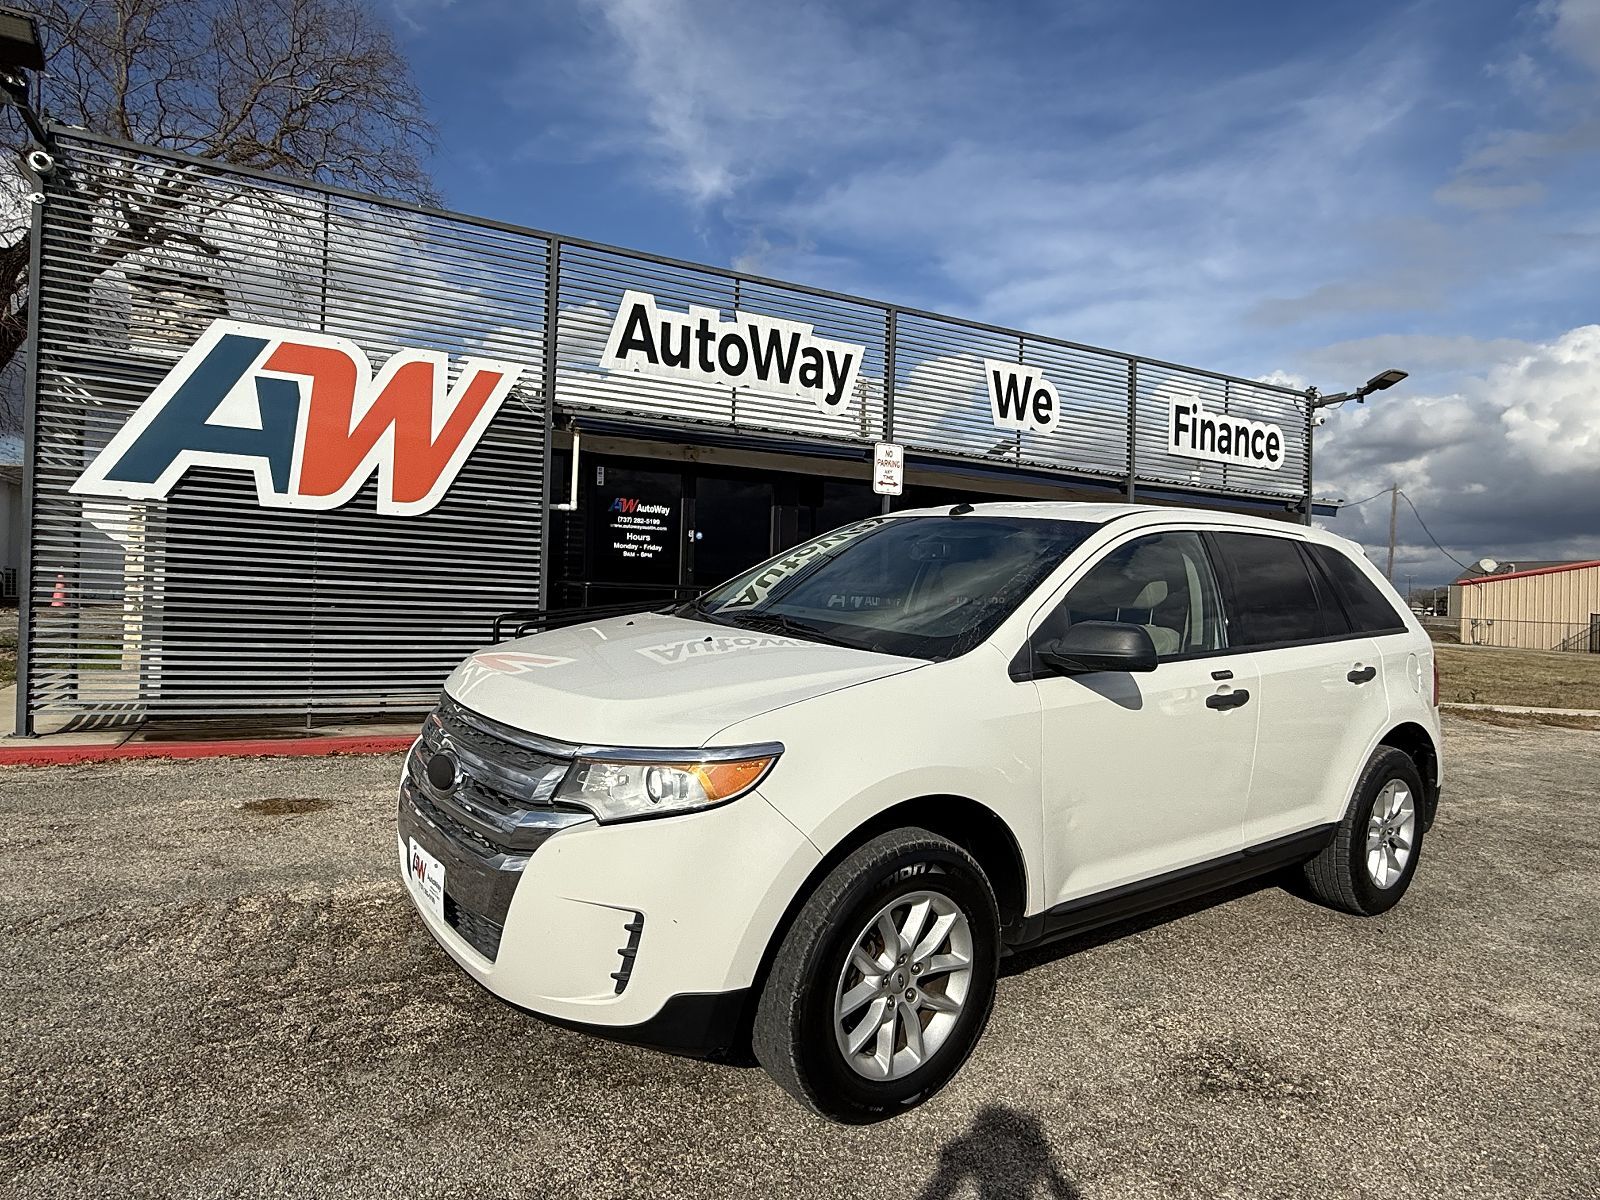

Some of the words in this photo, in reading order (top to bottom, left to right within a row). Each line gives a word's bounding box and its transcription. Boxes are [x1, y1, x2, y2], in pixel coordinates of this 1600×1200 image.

[615, 303, 853, 406] AutoWay
[993, 370, 1053, 425] We
[1174, 403, 1281, 462] Finance
[102, 333, 504, 503] AW
[885, 450, 893, 458] NO
[877, 458, 900, 468] PARKING
[636, 503, 670, 516] AutoWay
[626, 533, 651, 541] Hours
[613, 542, 638, 551] Monday
[643, 544, 662, 552] Friday
